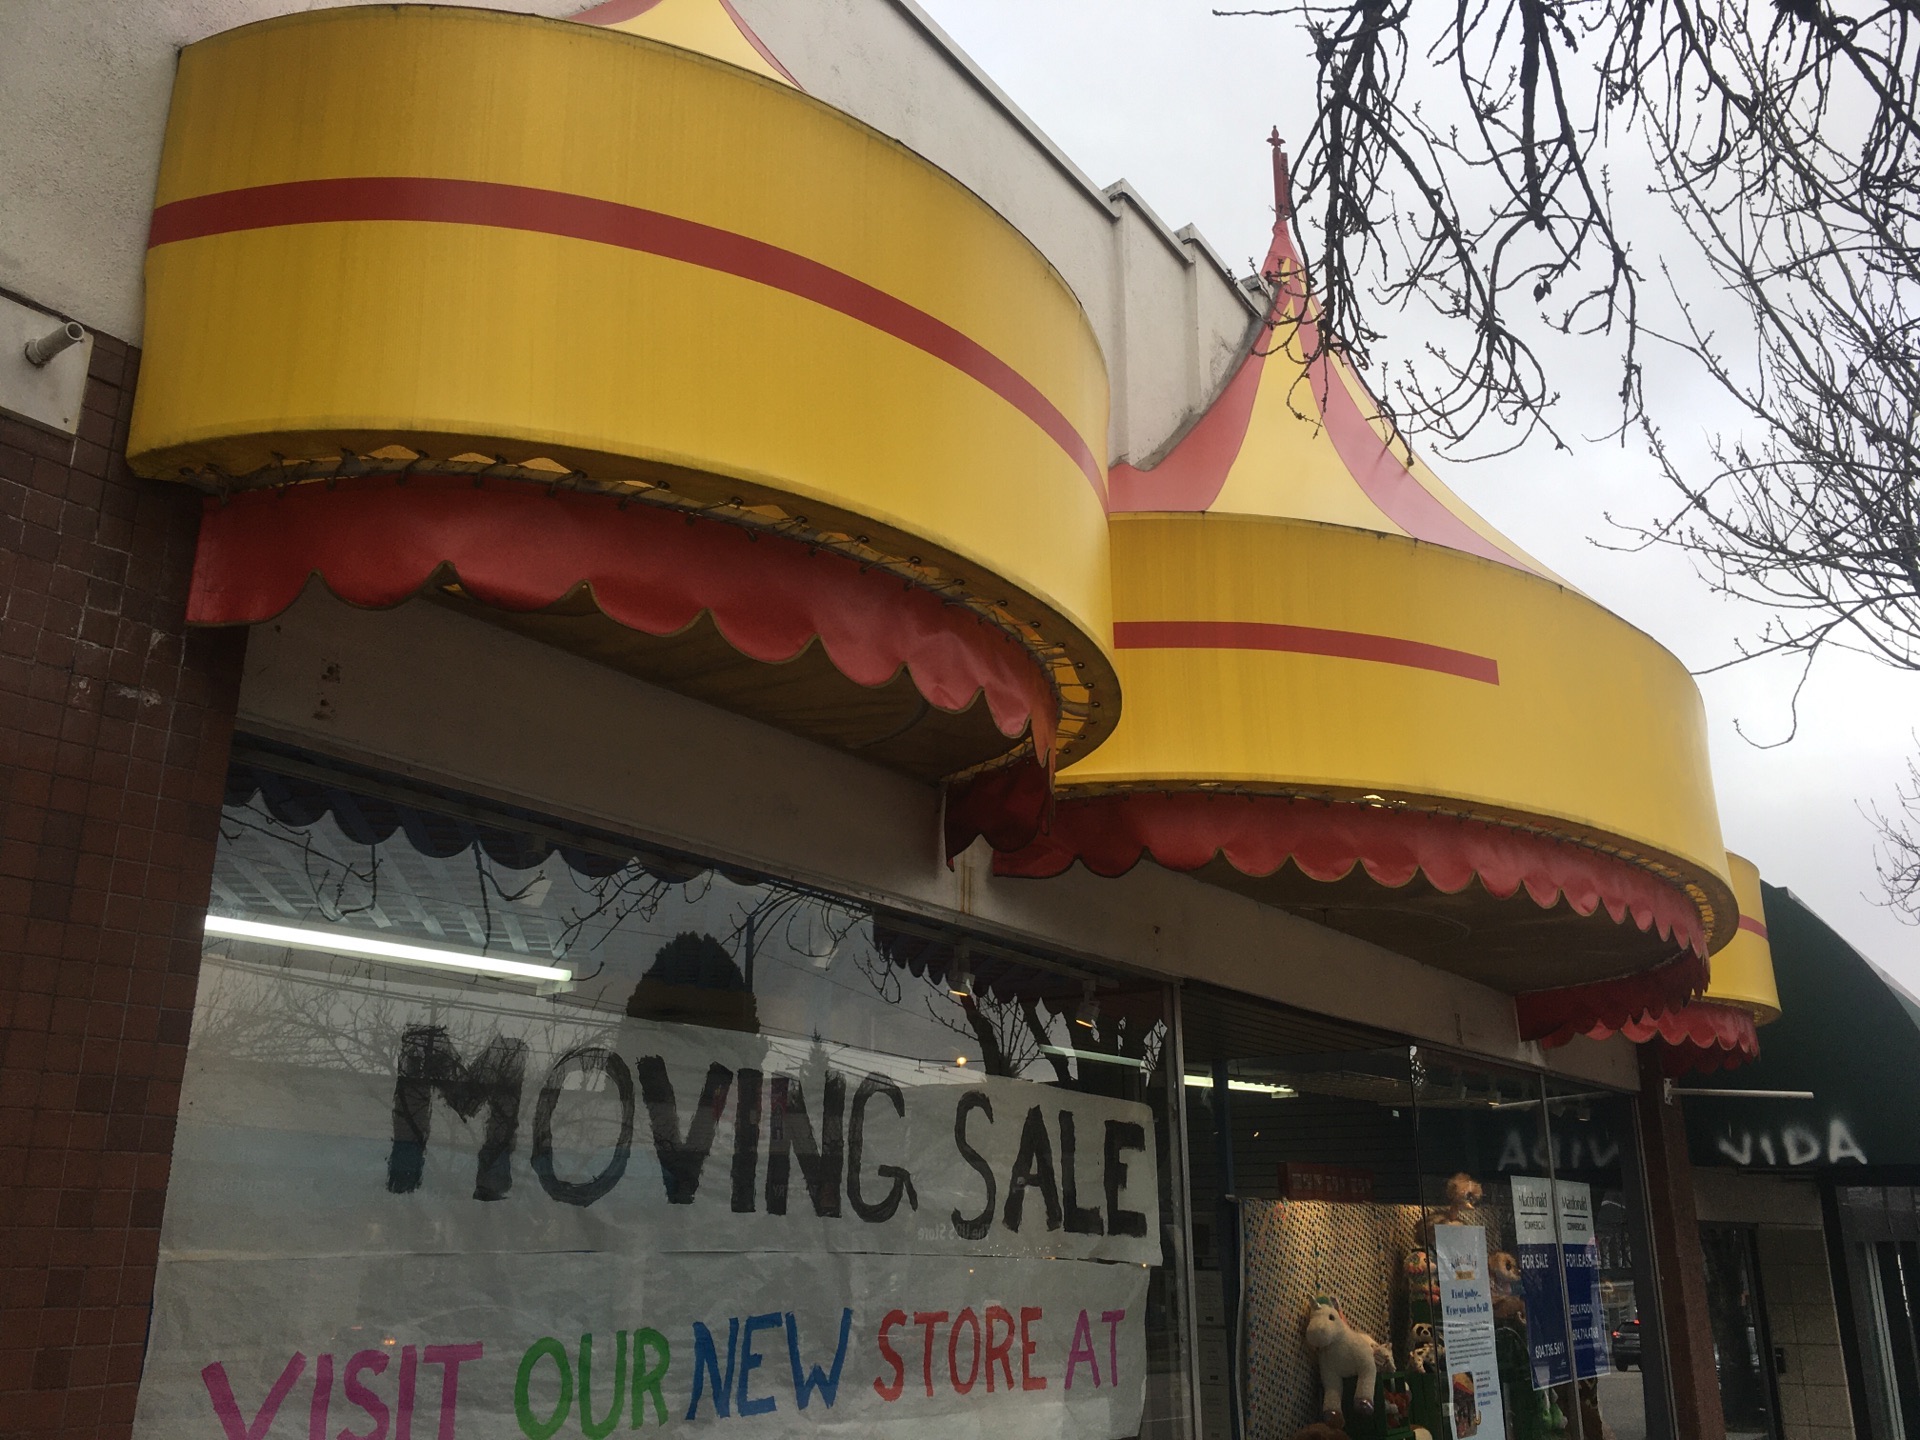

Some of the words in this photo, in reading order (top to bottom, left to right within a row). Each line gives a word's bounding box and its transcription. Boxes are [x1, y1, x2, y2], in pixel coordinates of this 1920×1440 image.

[387, 1024, 918, 1222] MOVING
[951, 1090, 1147, 1240] SALE
[1717, 1113, 1868, 1165] VIDA
[1521, 1254, 1534, 1269] FOR
[1535, 1253, 1549, 1268] SALE
[200, 1340, 483, 1440] VISIT
[514, 1326, 671, 1440] OUR
[685, 1307, 854, 1420] NEW
[873, 1305, 1047, 1402] STORE
[1064, 1309, 1126, 1391] AT
